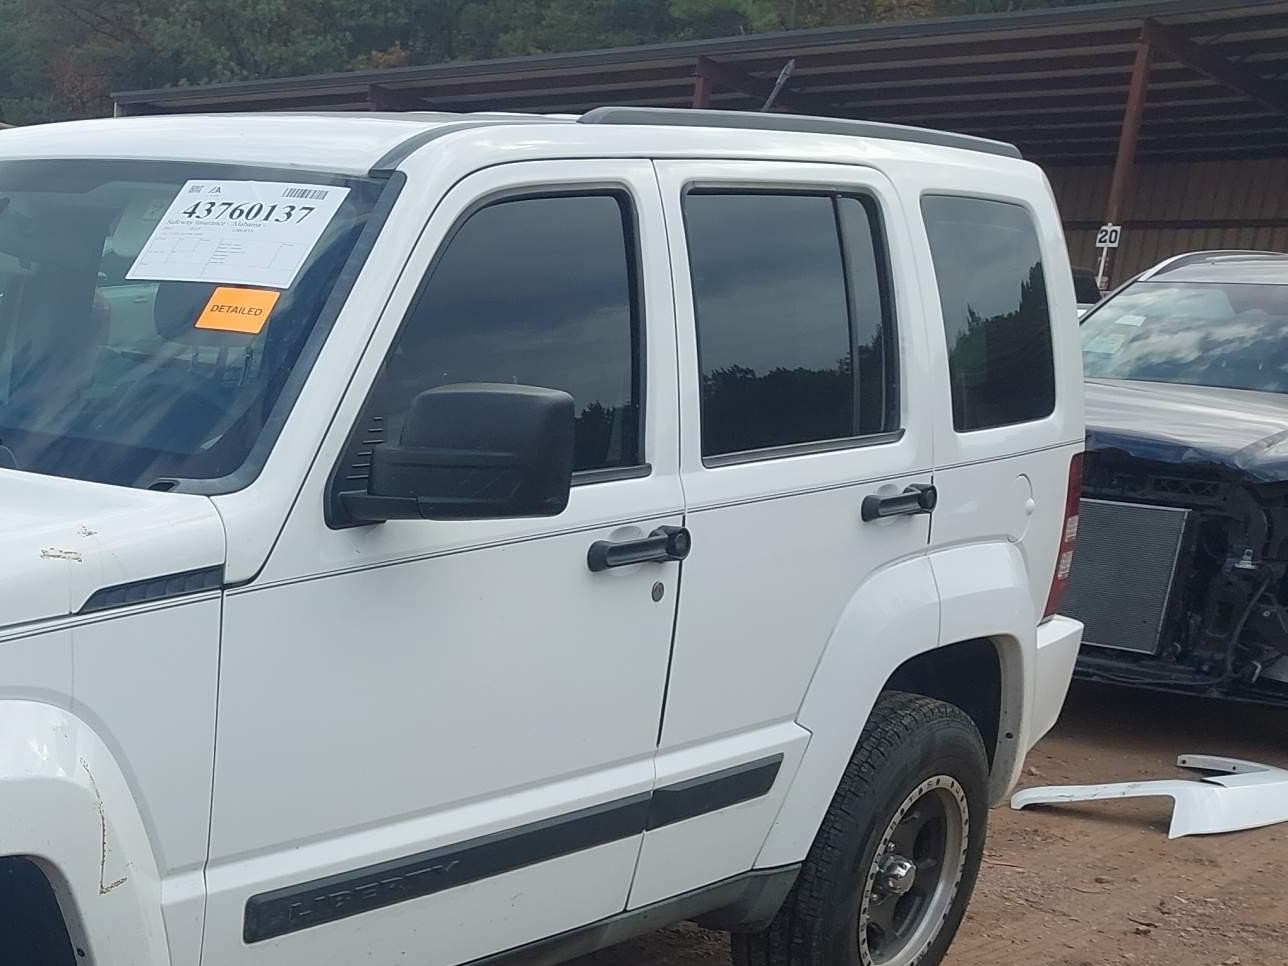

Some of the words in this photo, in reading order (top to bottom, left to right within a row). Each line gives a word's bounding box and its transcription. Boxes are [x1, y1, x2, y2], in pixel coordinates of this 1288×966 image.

[182, 200, 316, 225] 43760137
[1098, 228, 1119, 244] 20
[209, 303, 263, 317] DETAILED
